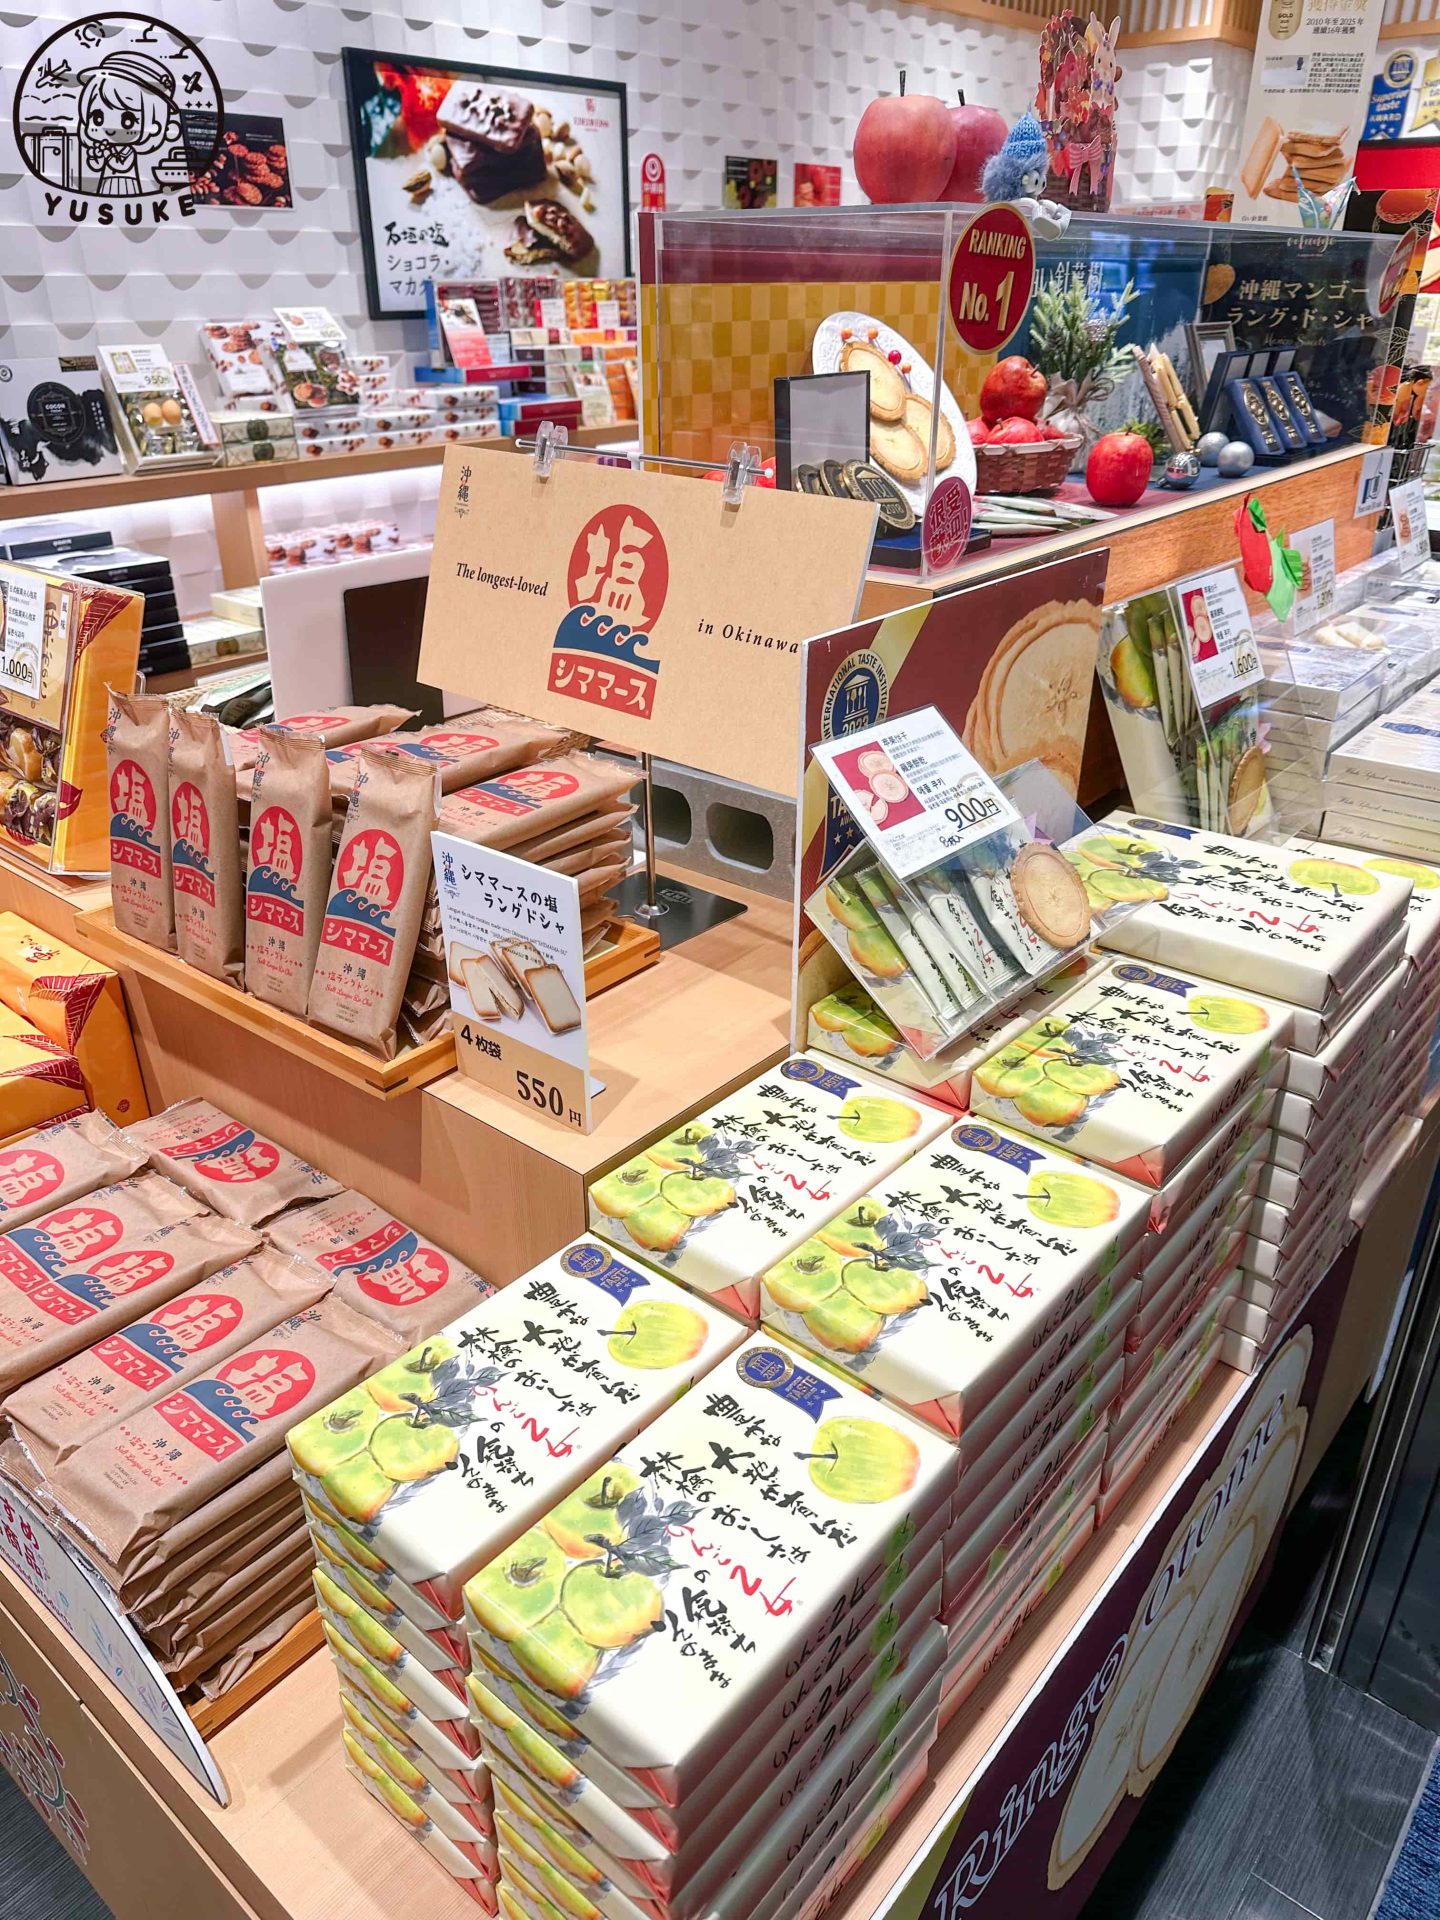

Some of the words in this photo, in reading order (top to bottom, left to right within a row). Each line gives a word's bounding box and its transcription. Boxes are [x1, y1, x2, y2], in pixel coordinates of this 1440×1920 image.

[384, 221, 450, 248] 石垣の塩
[968, 228, 1027, 260] RANKING
[1239, 280, 1370, 301] 沖縄マンゴー
[1227, 307, 1373, 330] ラング・ド・シャ
[458, 465, 472, 502] 沖縄
[456, 561, 475, 581] The
[477, 564, 550, 597] longest-loved
[575, 513, 655, 624] 塩
[697, 618, 714, 636] in
[722, 623, 799, 654] Okinawa
[555, 657, 649, 711] シママース
[823, 658, 856, 740] INTERNATIONAL
[857, 653, 878, 667] TASTE
[875, 664, 889, 720] INSTITUTE
[459, 790, 527, 816] シママース
[945, 797, 998, 829] 900円
[112, 842, 158, 875] シママース
[441, 851, 457, 887] 沖縄
[174, 868, 214, 904] シママース
[460, 863, 559, 914] シママースの塩
[250, 898, 302, 932] シママース
[483, 892, 566, 935] ラングドシャ
[325, 921, 388, 961] シママース
[322, 1225, 401, 1265] シママース
[600, 1267, 631, 1297] TASTE
[34, 1287, 91, 1324] シママース
[96, 1338, 167, 1387] シママース
[786, 1375, 817, 1401] TASTE
[161, 1396, 238, 1456] シママース
[935, 1634, 1131, 1920] Ringo
[1141, 1392, 1288, 1633] otome
